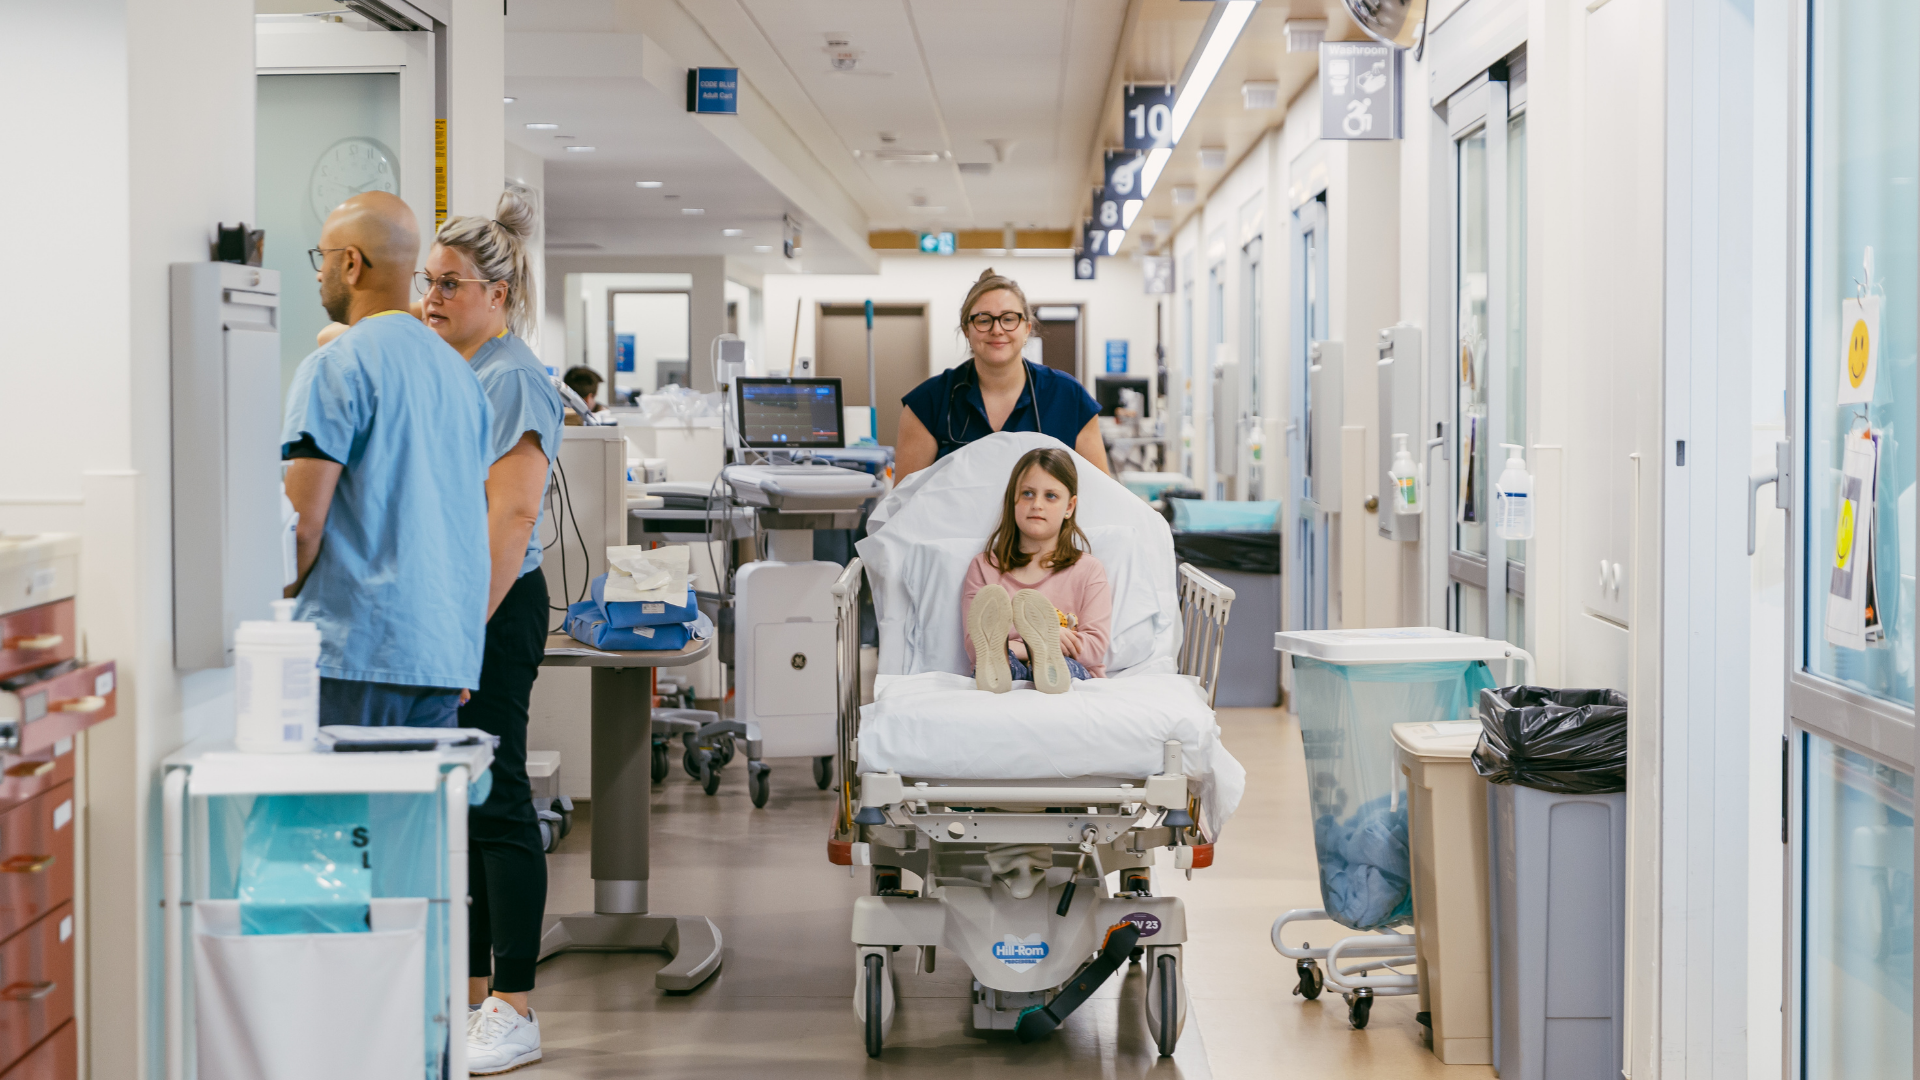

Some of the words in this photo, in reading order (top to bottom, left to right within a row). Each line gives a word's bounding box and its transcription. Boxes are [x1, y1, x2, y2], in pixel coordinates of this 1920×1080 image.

[1329, 44, 1388, 55] Washroom
[1128, 103, 1172, 139] 10
[1111, 164, 1134, 195] 9
[1099, 200, 1118, 227] 8
[1089, 230, 1106, 253] 7
[1077, 258, 1093, 279] 6
[352, 827, 370, 848] S
[1145, 920, 1159, 930] 23
[996, 945, 1044, 956] Hill-Rom
